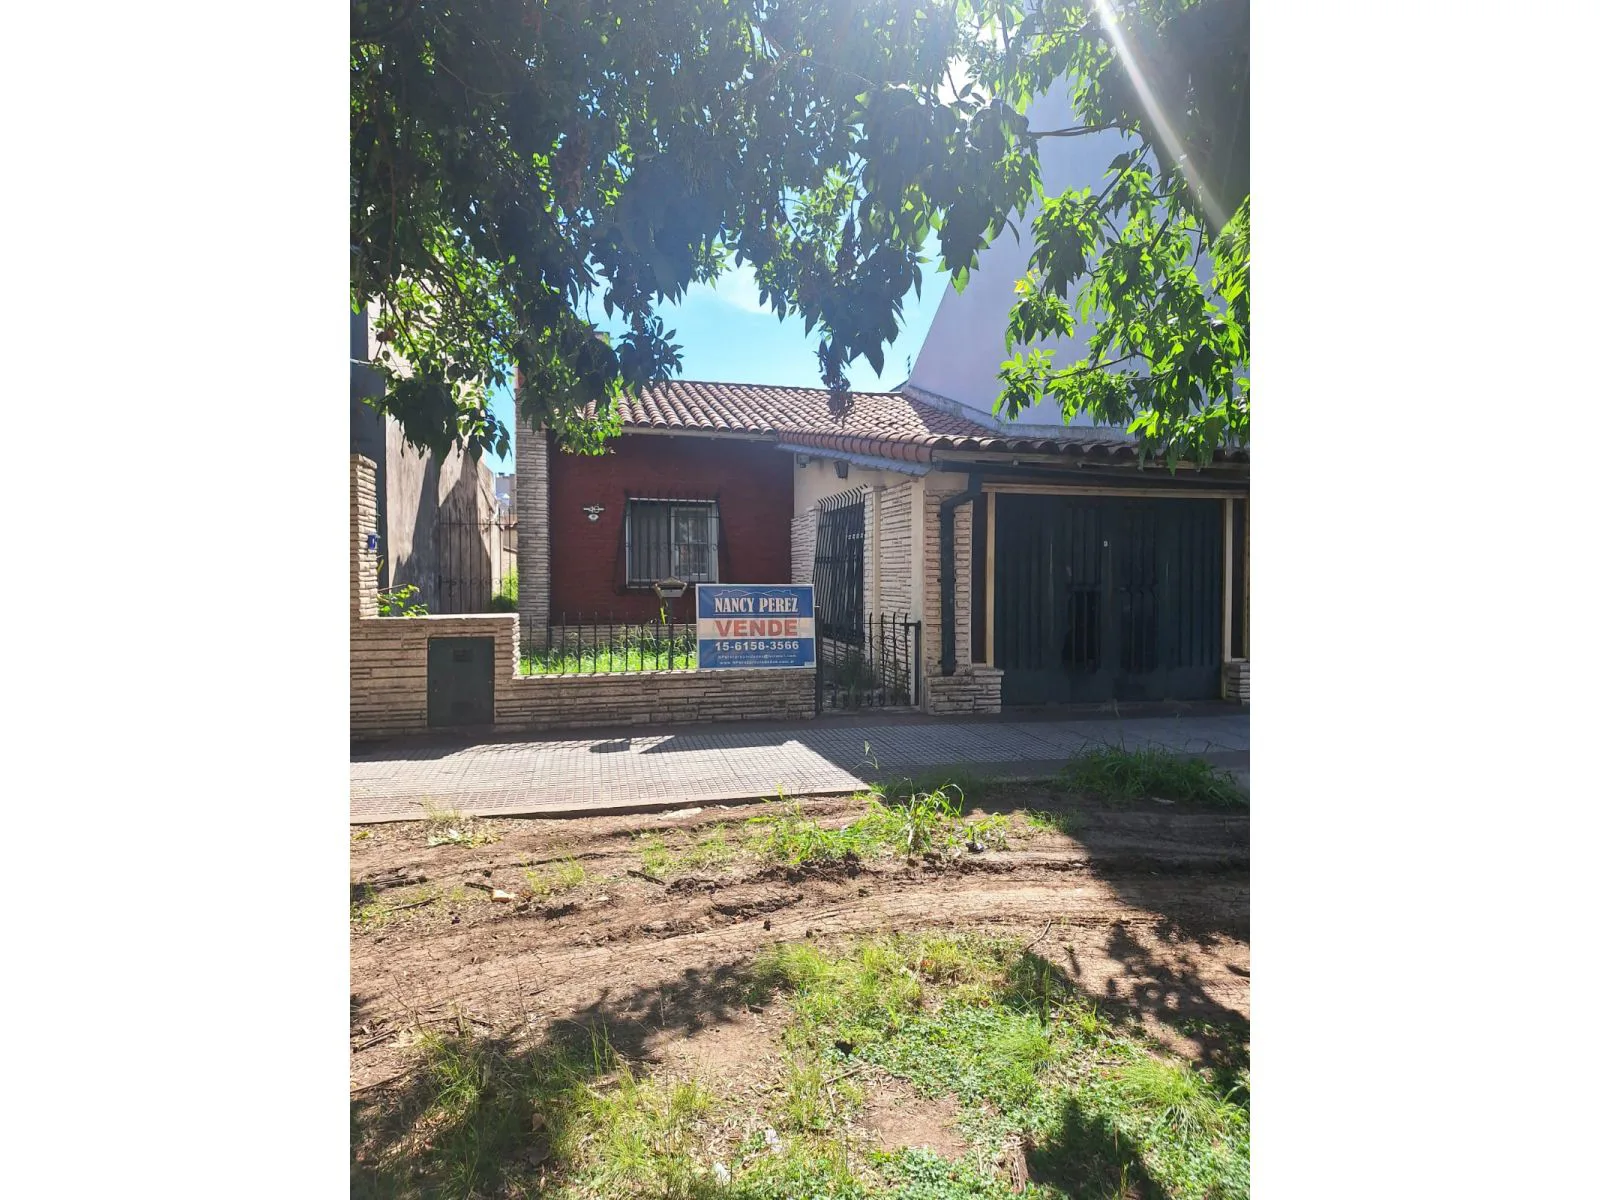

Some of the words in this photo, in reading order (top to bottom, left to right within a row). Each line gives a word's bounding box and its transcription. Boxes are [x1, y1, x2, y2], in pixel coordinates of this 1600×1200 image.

[715, 597, 755, 613] NANCY
[759, 597, 799, 613] PEREZ
[715, 619, 798, 637] VENDE
[715, 641, 799, 651] 15-6158-3566
